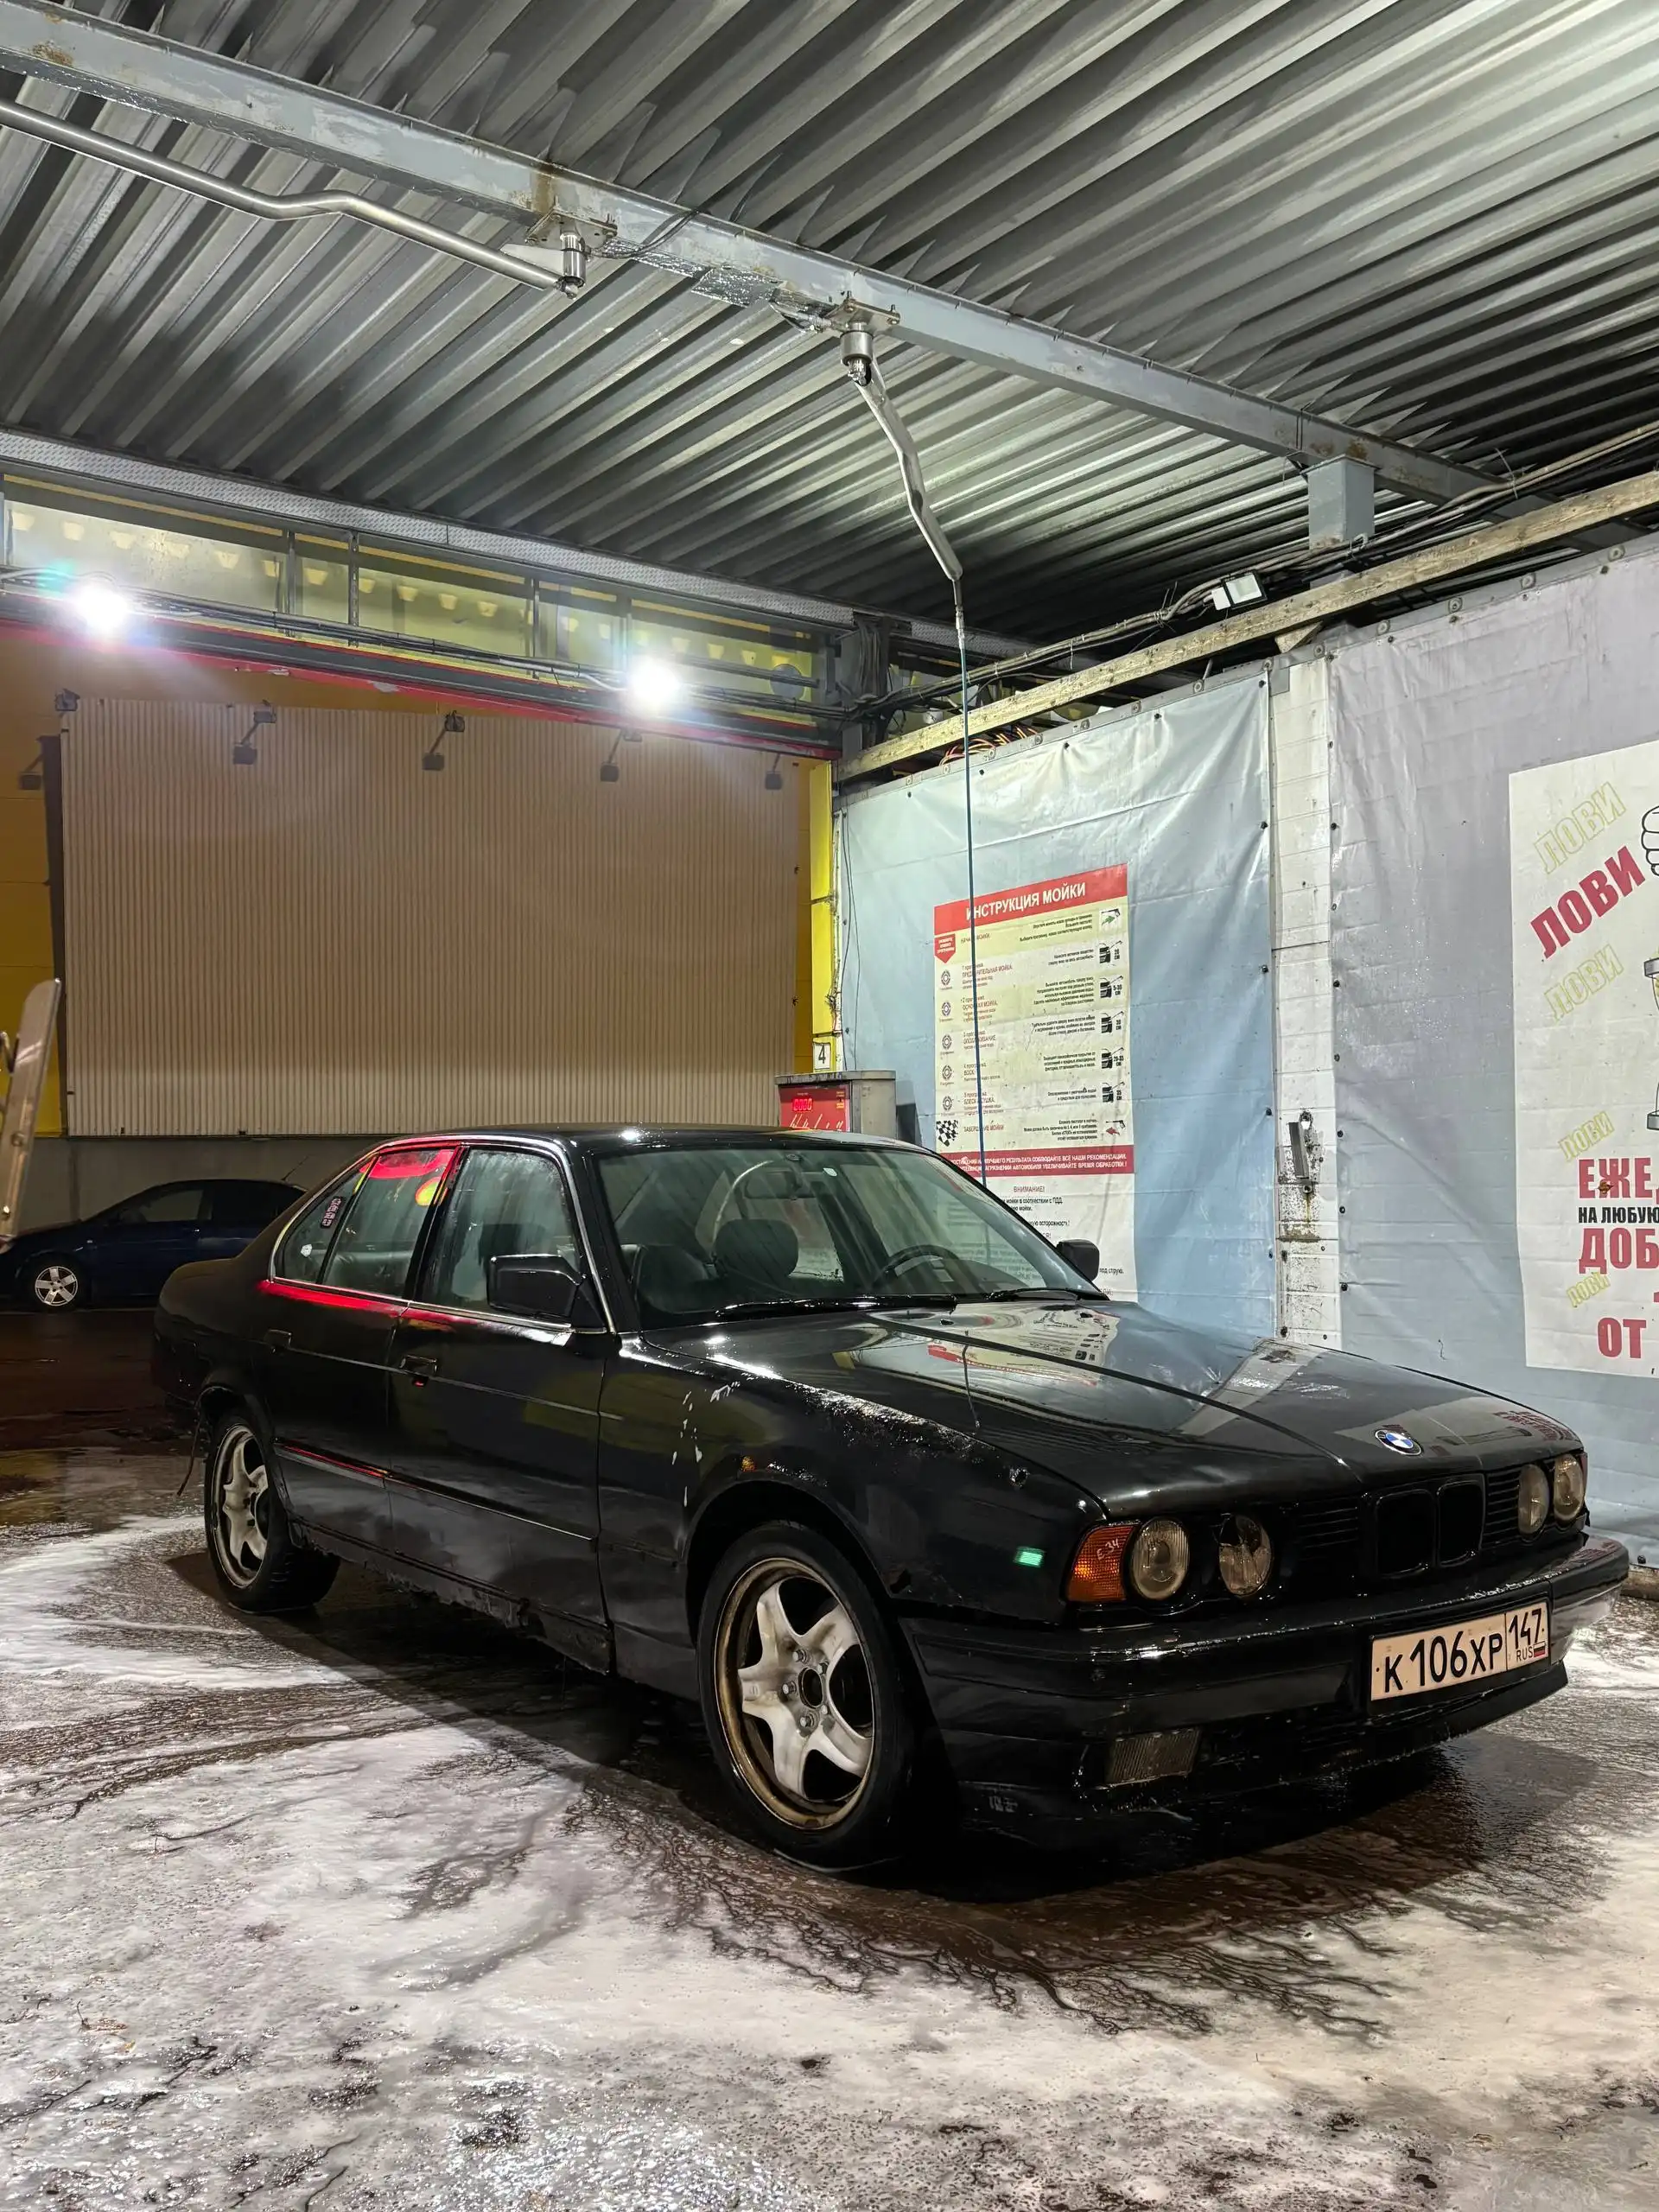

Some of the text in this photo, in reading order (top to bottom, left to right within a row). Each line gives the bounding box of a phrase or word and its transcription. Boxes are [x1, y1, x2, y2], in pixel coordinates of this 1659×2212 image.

[1533, 781, 1627, 874] ЛОВИ
[1042, 882, 1086, 906] МОЙКИ
[1531, 845, 1646, 959] ЛОВИ
[1545, 944, 1624, 1023] ЛОВИ
[818, 1046, 826, 1064] 4
[1559, 1111, 1615, 1161] ЛОВИ
[1579, 1158, 1659, 1205] ЕЖЕ
[1579, 1207, 1598, 1224] НА
[1566, 1271, 1611, 1307] ЛОВИ
[1598, 1318, 1647, 1358] ОТ
[1105, 1539, 1120, 1554] 34
[1509, 1608, 1542, 1649] 147
[1516, 1644, 1533, 1662] RUS
